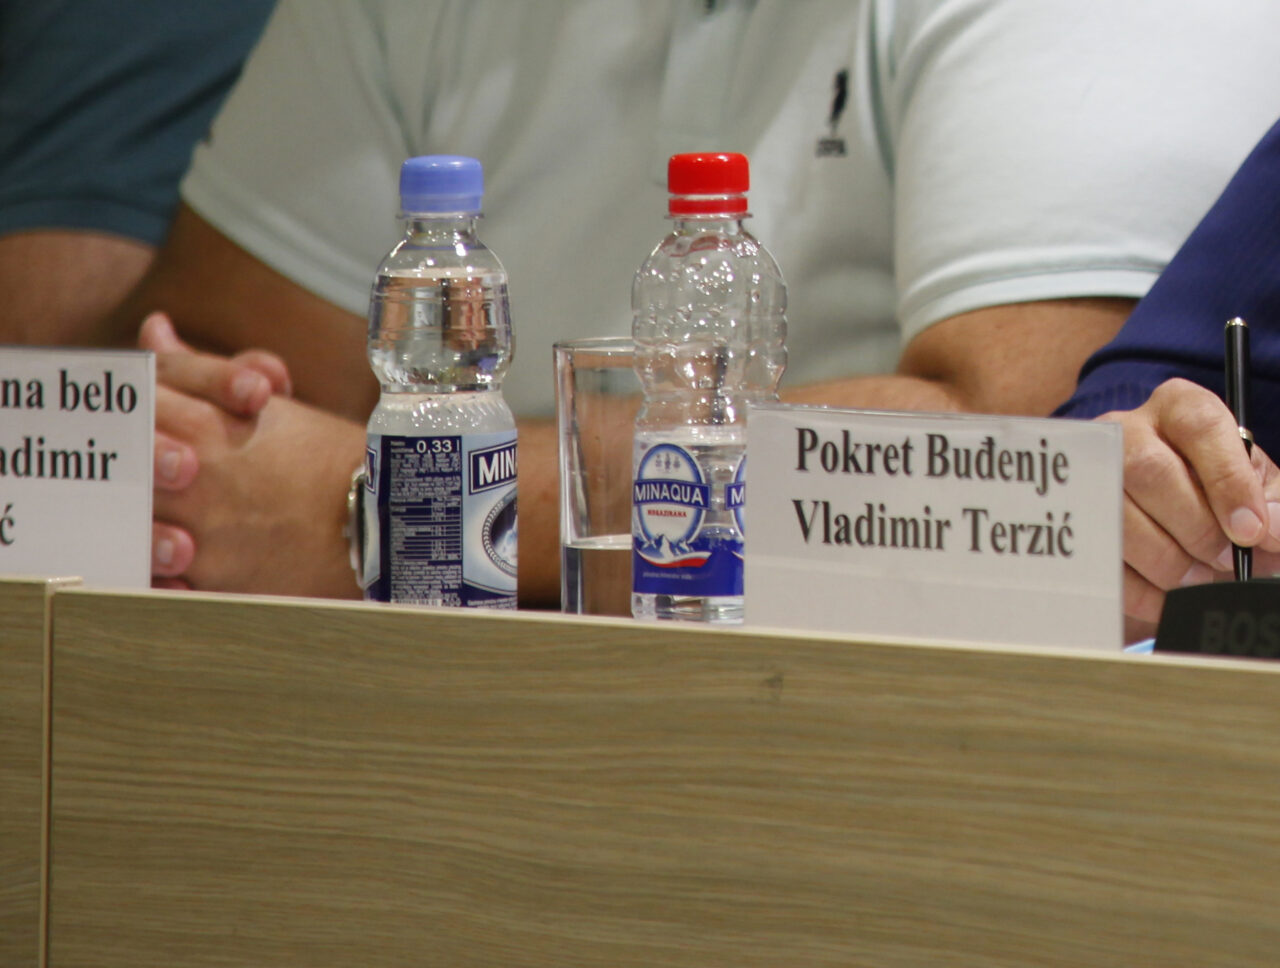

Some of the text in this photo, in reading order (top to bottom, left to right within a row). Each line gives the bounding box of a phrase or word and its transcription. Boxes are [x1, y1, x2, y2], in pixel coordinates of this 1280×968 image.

[59, 369, 138, 414] belo
[416, 439, 453, 455] 0,33
[795, 427, 1070, 497] Pokret Buđenje
[478, 451, 517, 486] MIN
[634, 483, 704, 506] MINAQUA
[792, 499, 1075, 558] Vladimir Terzić
